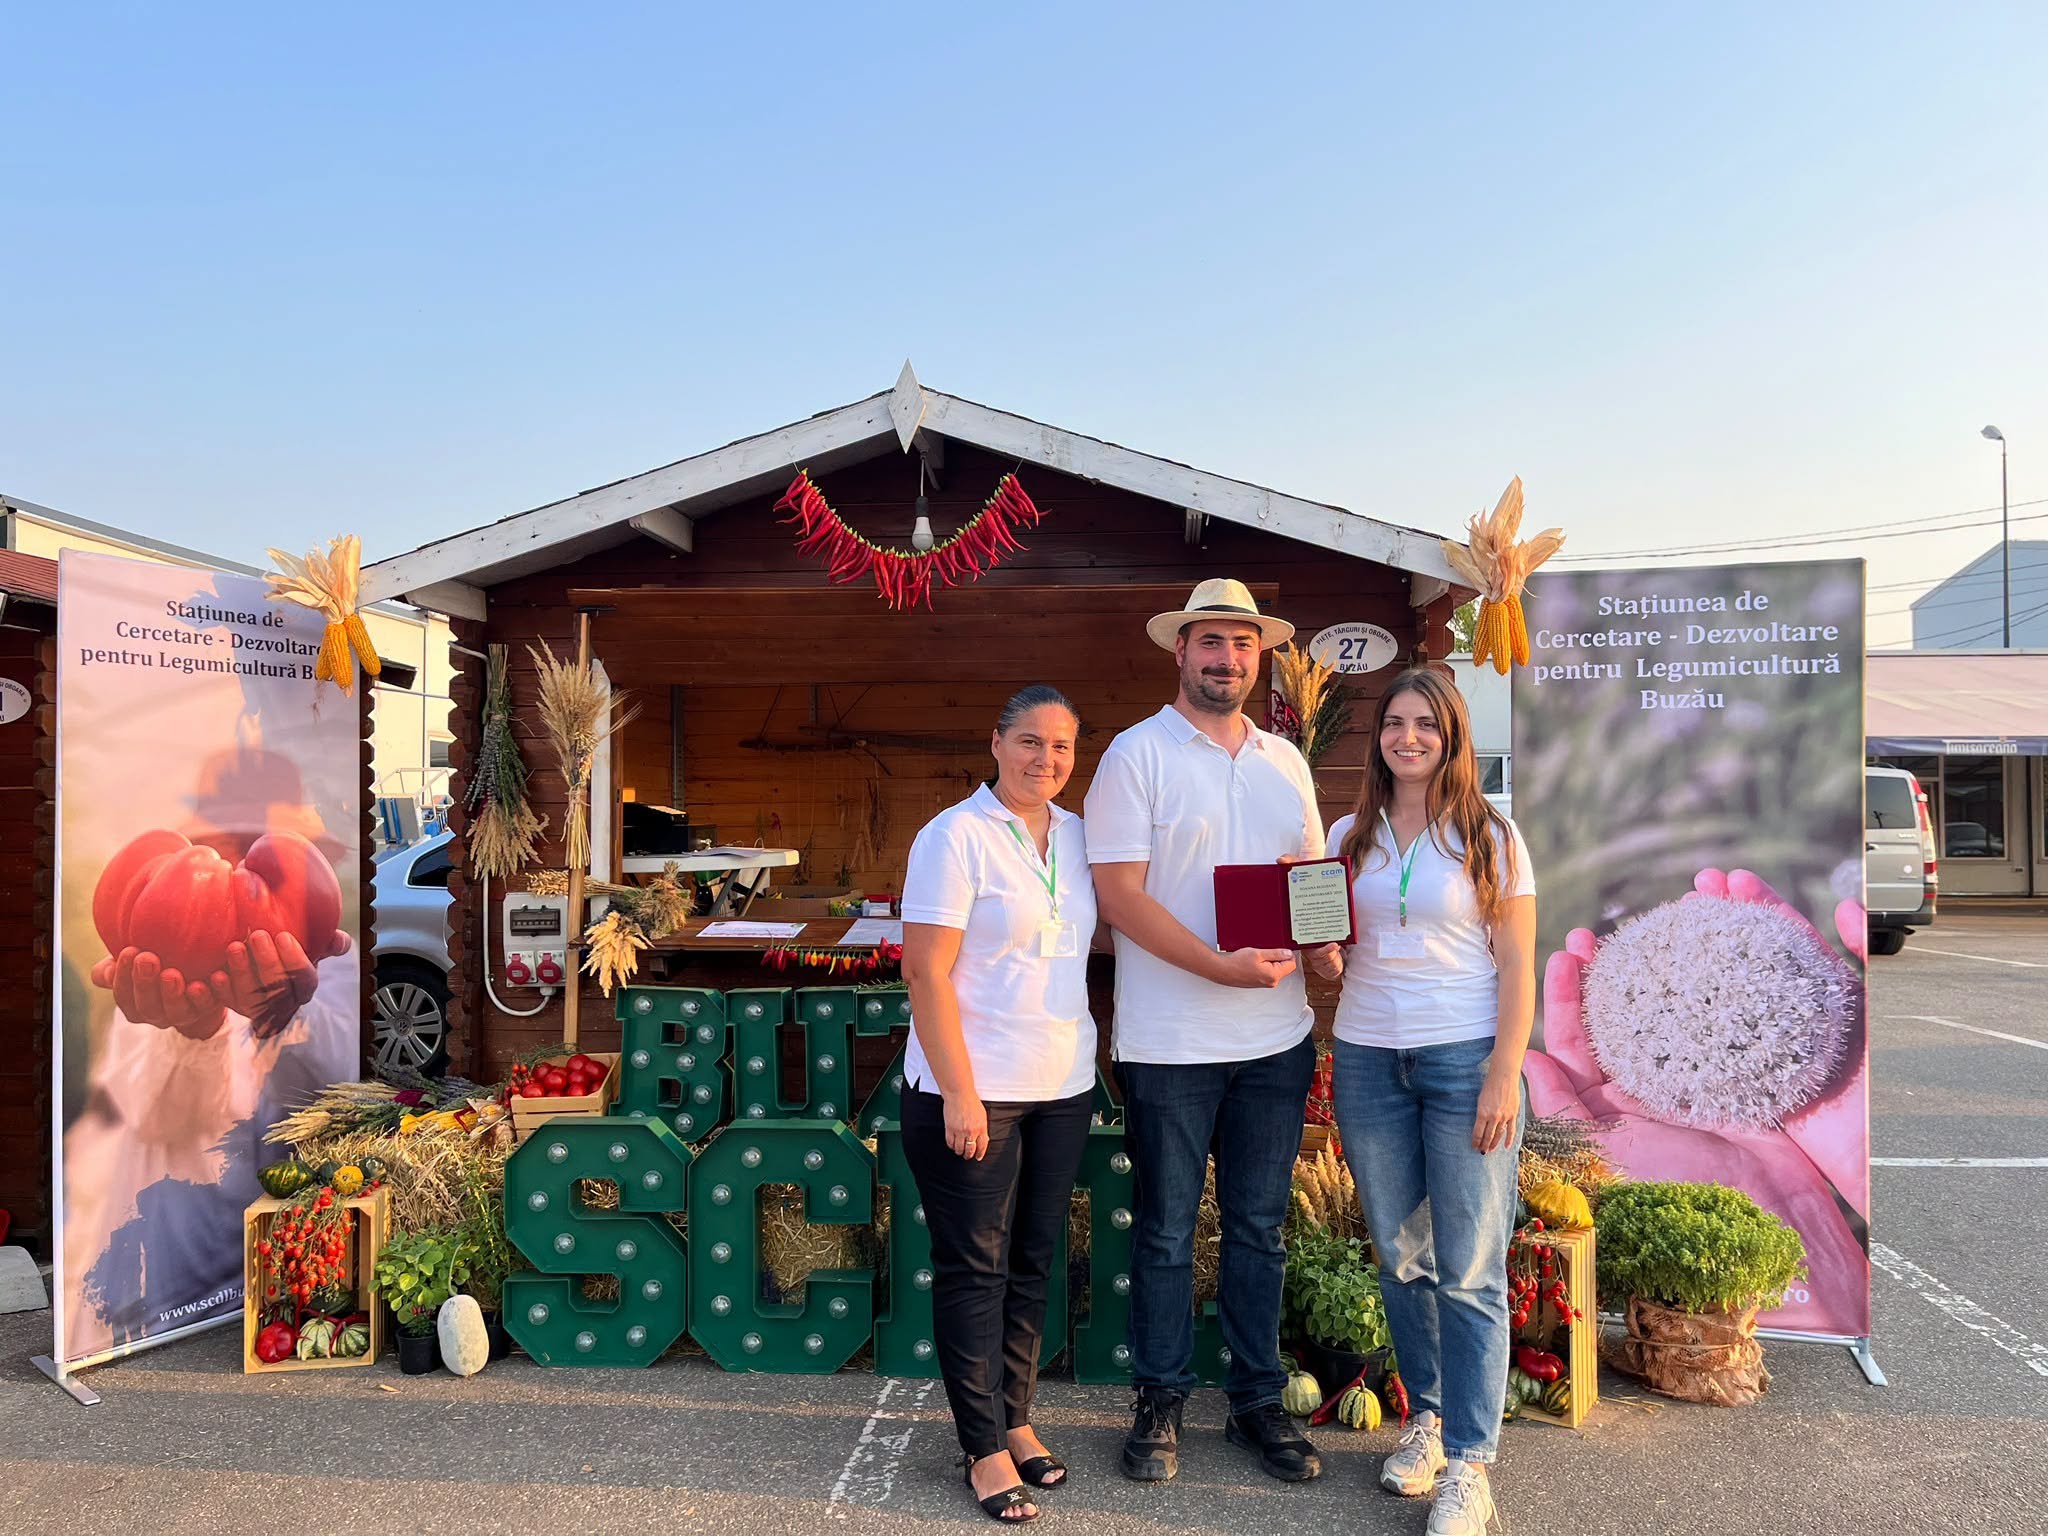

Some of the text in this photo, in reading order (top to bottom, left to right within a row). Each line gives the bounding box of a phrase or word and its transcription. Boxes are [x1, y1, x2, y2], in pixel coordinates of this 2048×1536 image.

[166, 600, 284, 628] Stațiunea de
[1598, 590, 1769, 619] Stațiunea de
[116, 621, 213, 646] Cercetare
[1535, 629, 1662, 649] Cercetare
[1686, 621, 1839, 645] Dezvoltare
[1339, 637, 1368, 660] 27
[80, 648, 153, 666] pentru
[160, 651, 297, 679] Legumicultură
[1533, 652, 1841, 686] pentru Legumicultură
[1640, 688, 1725, 710] Buzău
[160, 1288, 245, 1322] www.scdlbu
